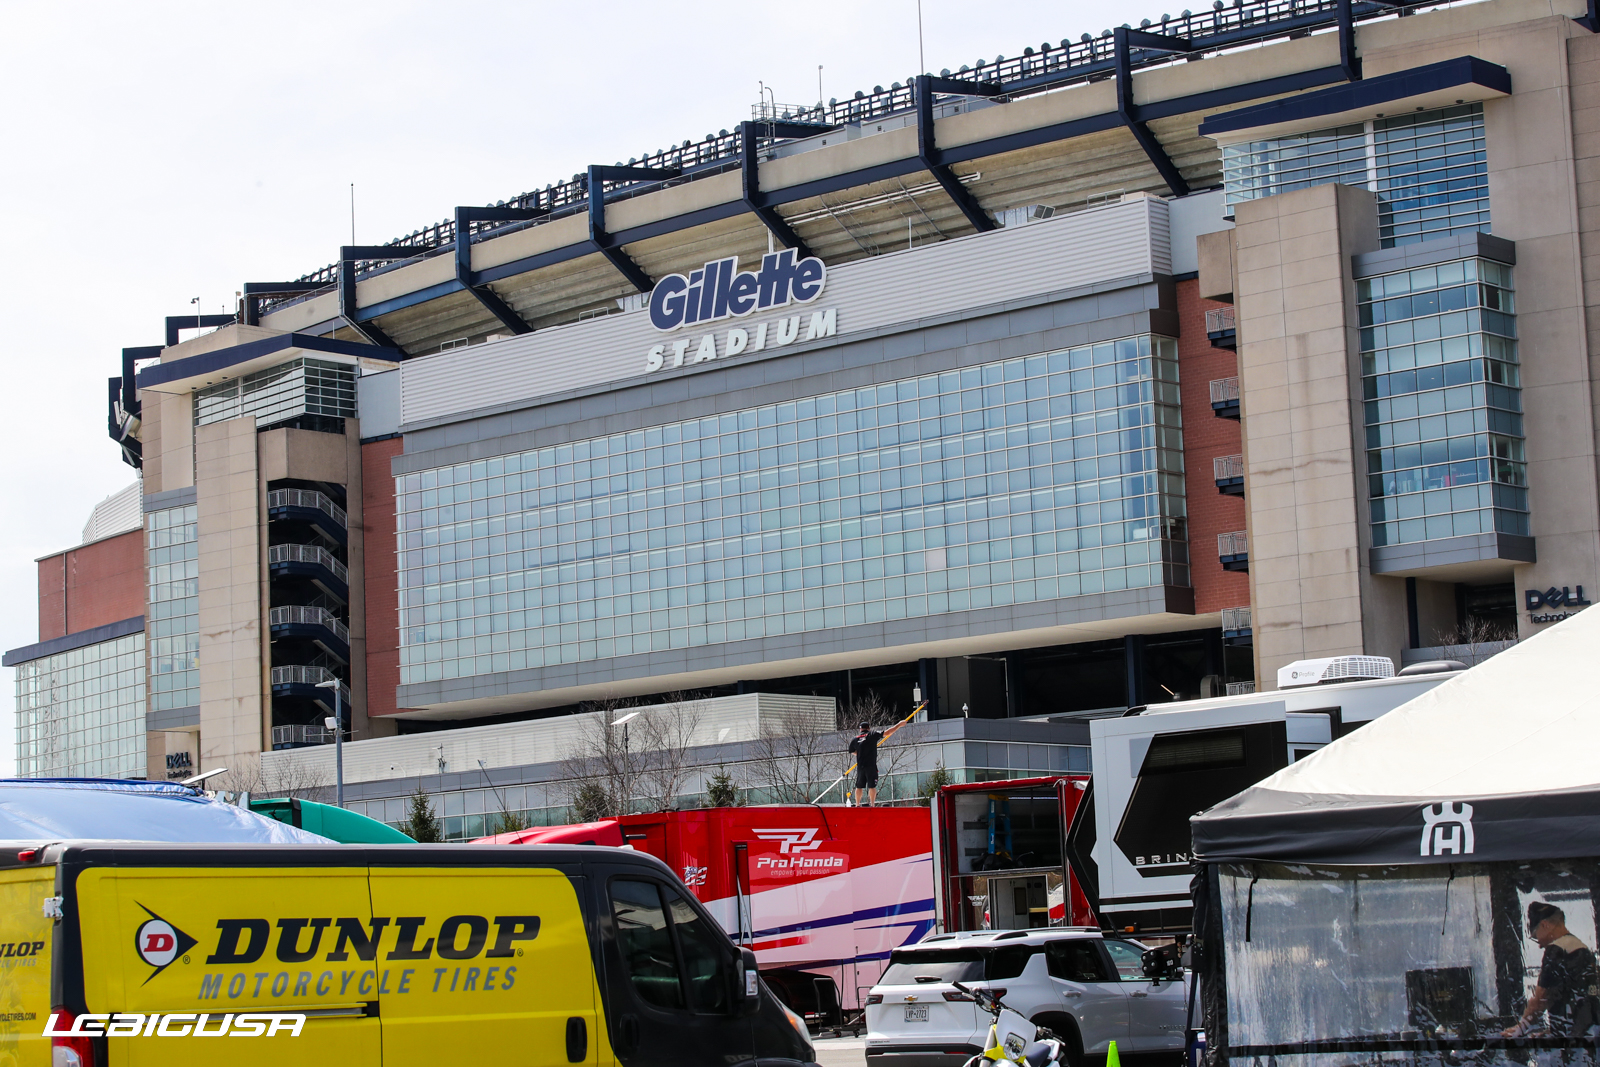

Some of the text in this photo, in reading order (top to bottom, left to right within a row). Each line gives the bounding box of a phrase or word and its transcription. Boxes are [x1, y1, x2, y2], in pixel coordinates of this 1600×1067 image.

[649, 247, 827, 332] Gillette
[645, 308, 838, 372] STADIUM
[1525, 585, 1592, 610] DELL
[166, 752, 192, 769] DELL
[770, 867, 830, 877] empower your passion
[1135, 853, 1194, 865] BRIN
[205, 915, 541, 965] DUNLOP
[197, 966, 518, 1000] MOTORCYCLE TIRES
